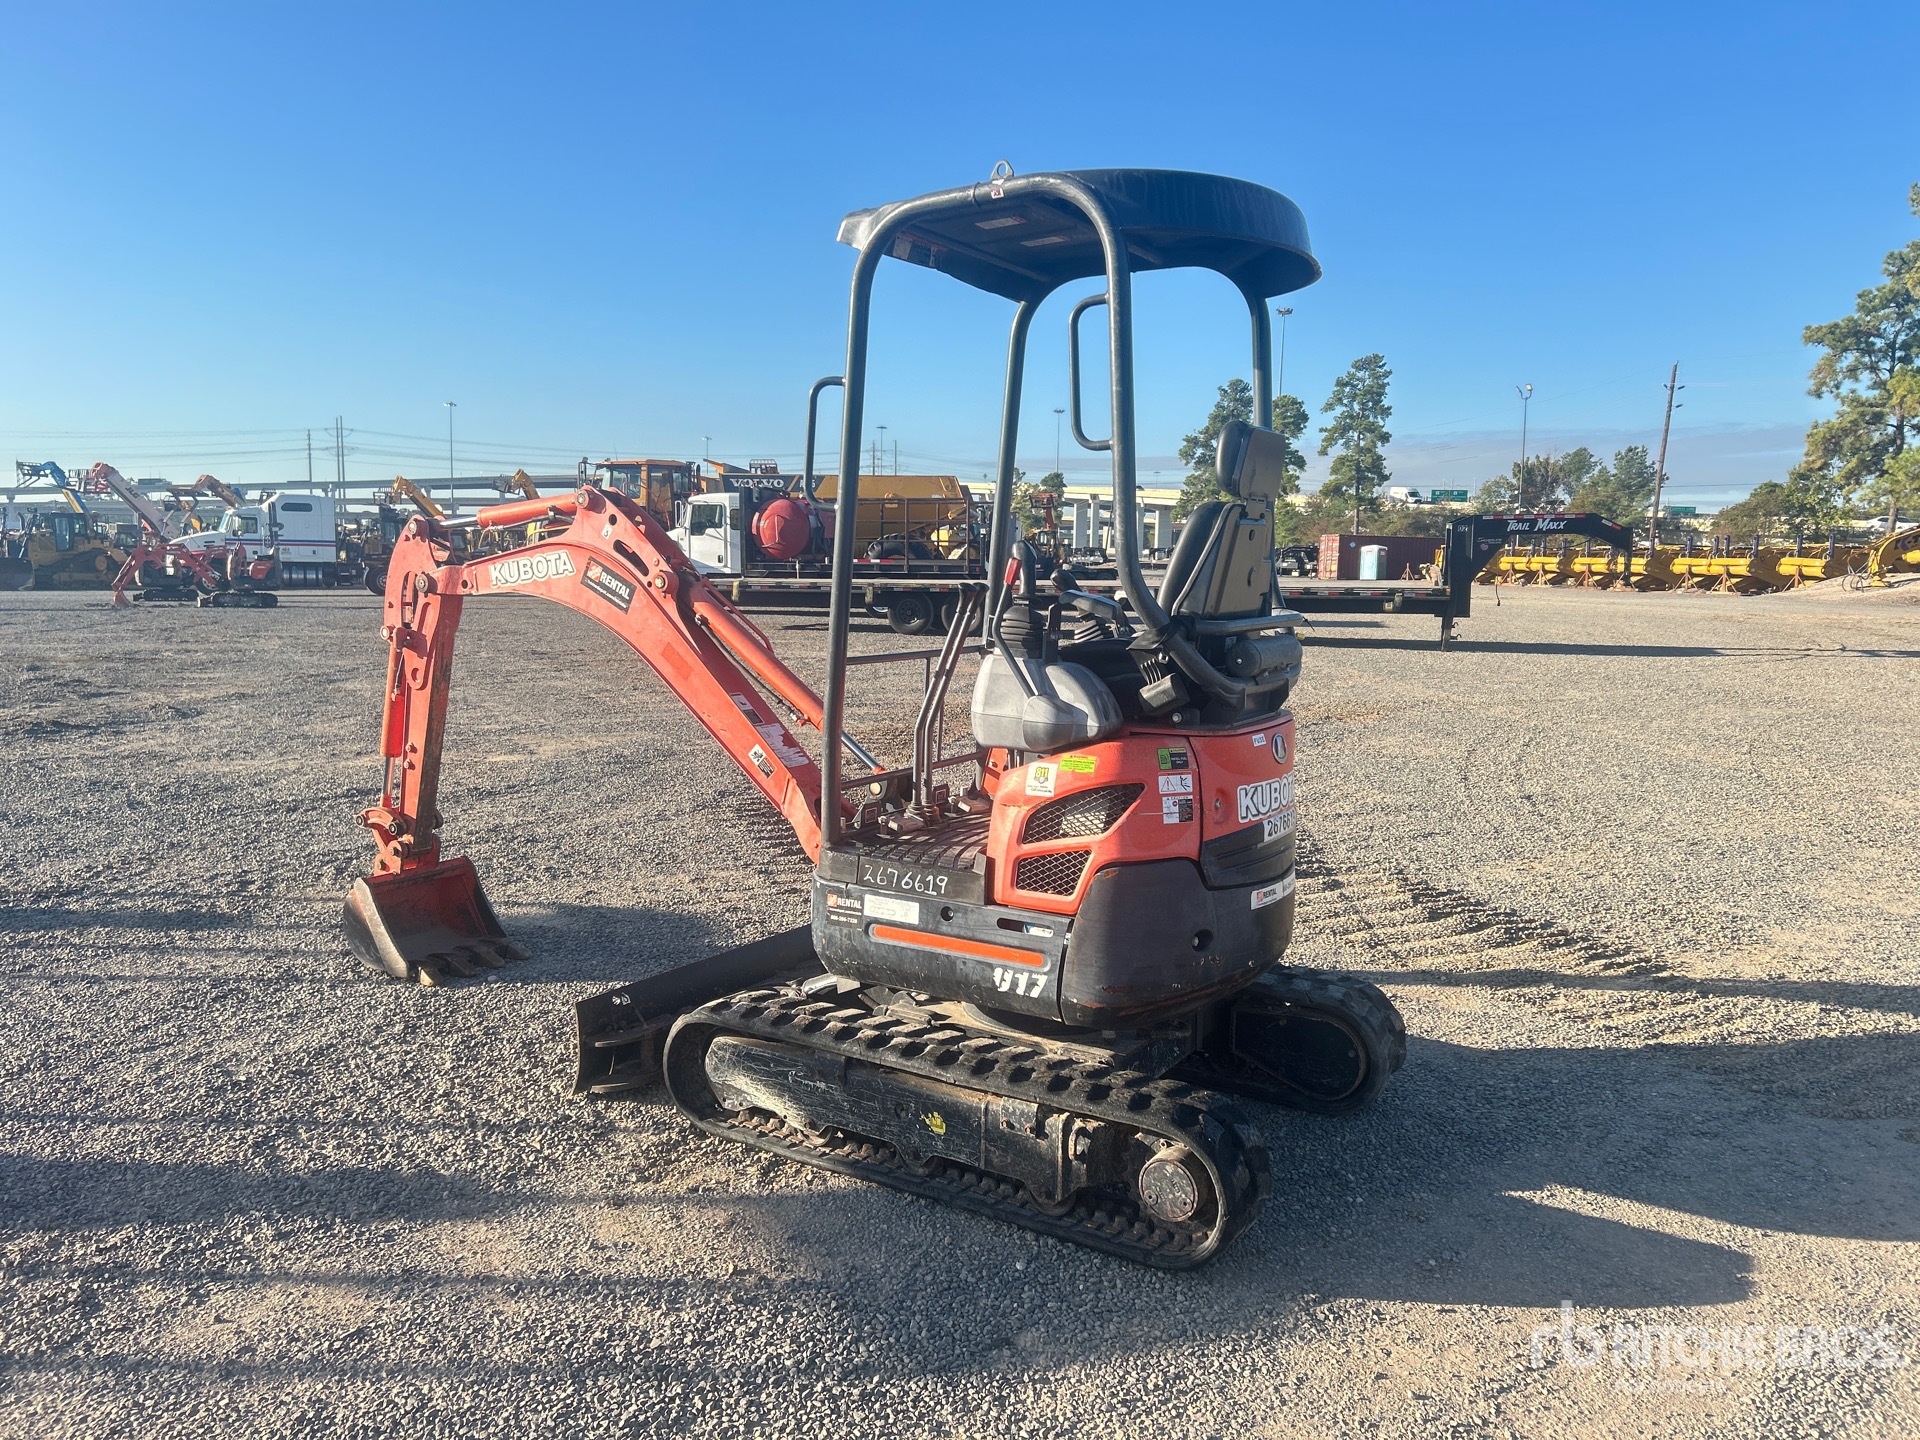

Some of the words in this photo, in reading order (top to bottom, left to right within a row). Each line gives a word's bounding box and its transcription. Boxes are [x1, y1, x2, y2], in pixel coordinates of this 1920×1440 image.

[125, 487, 139, 498] JLG
[730, 478, 784, 489] VOLVO
[799, 479, 816, 488] A5
[1533, 518, 1568, 532] MAXX
[489, 551, 575, 587] KUBOTA
[600, 571, 630, 600] RENTAL
[1035, 767, 1049, 778] 811
[1238, 772, 1295, 820] KUBOT
[863, 864, 949, 896] 2676619
[837, 897, 863, 909] RENTAL
[993, 967, 1048, 998] U17
